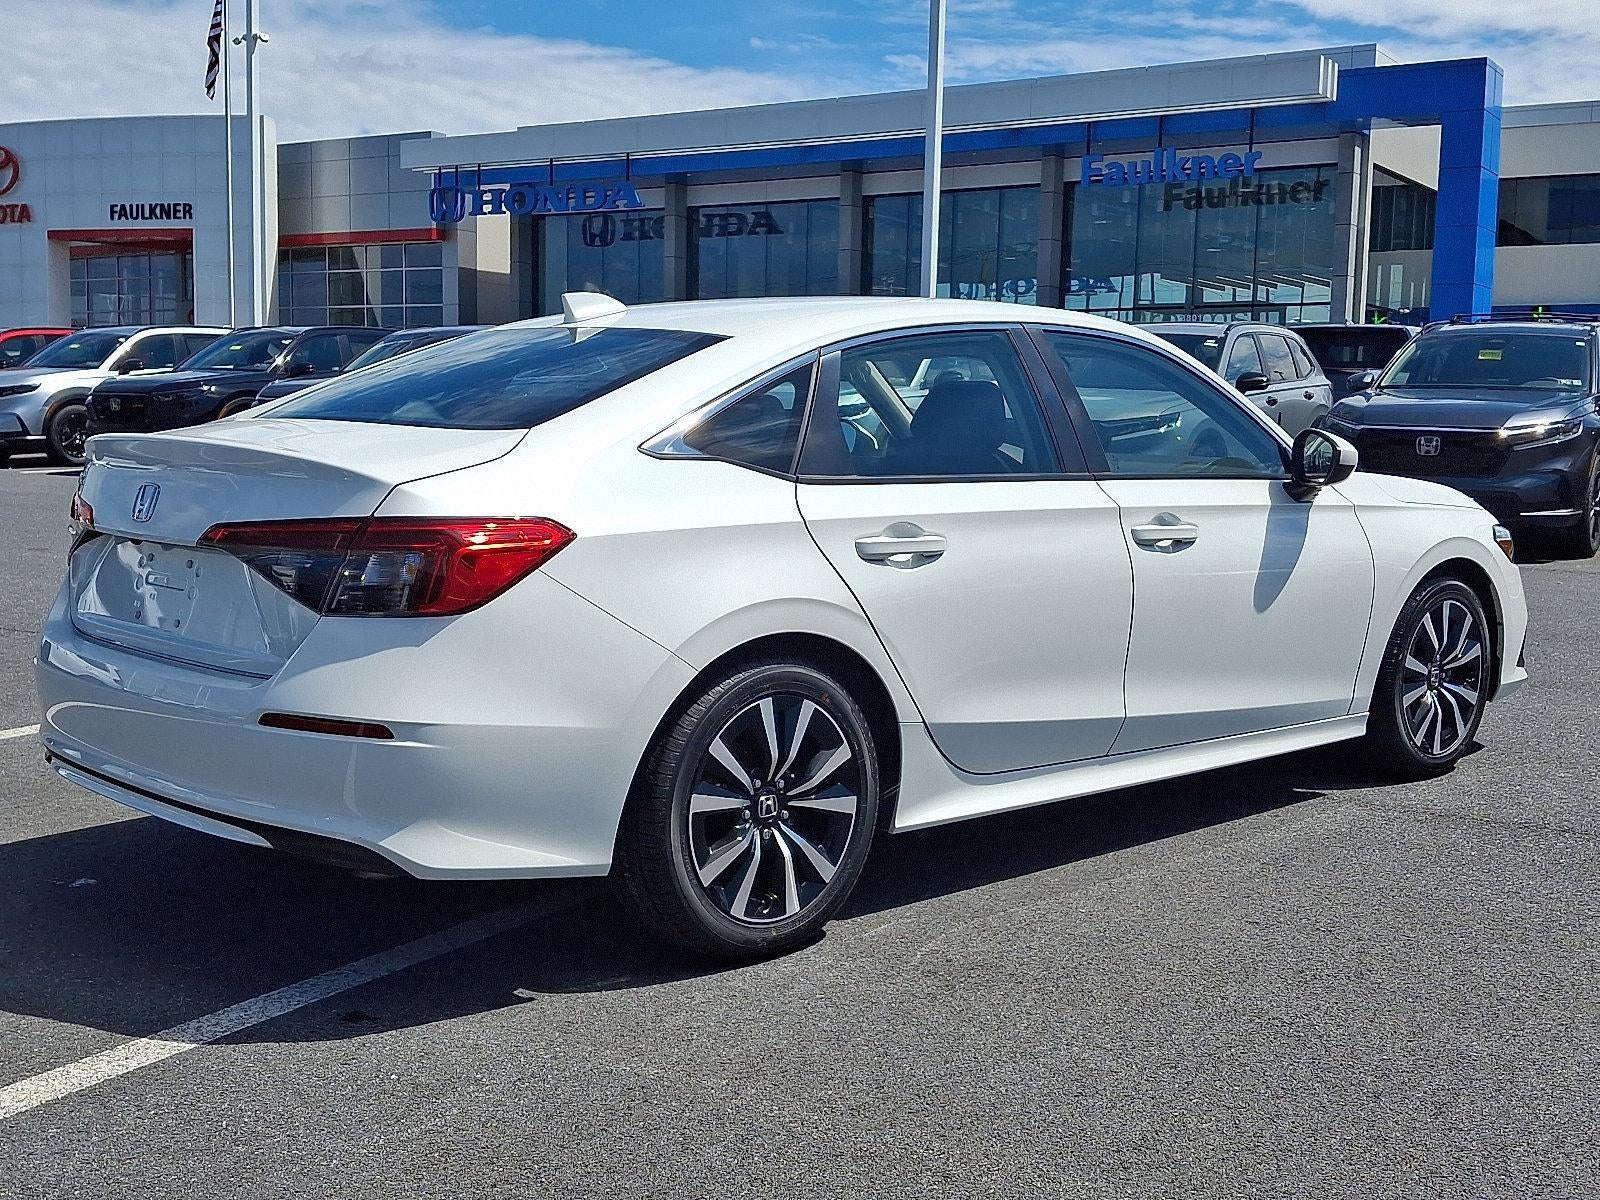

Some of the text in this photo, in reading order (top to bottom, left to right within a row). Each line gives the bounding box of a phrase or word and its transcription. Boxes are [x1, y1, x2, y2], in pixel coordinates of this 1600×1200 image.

[1081, 148, 1263, 187] Faulkner
[109, 203, 193, 220] FAULKNER
[468, 182, 644, 216] HONDA
